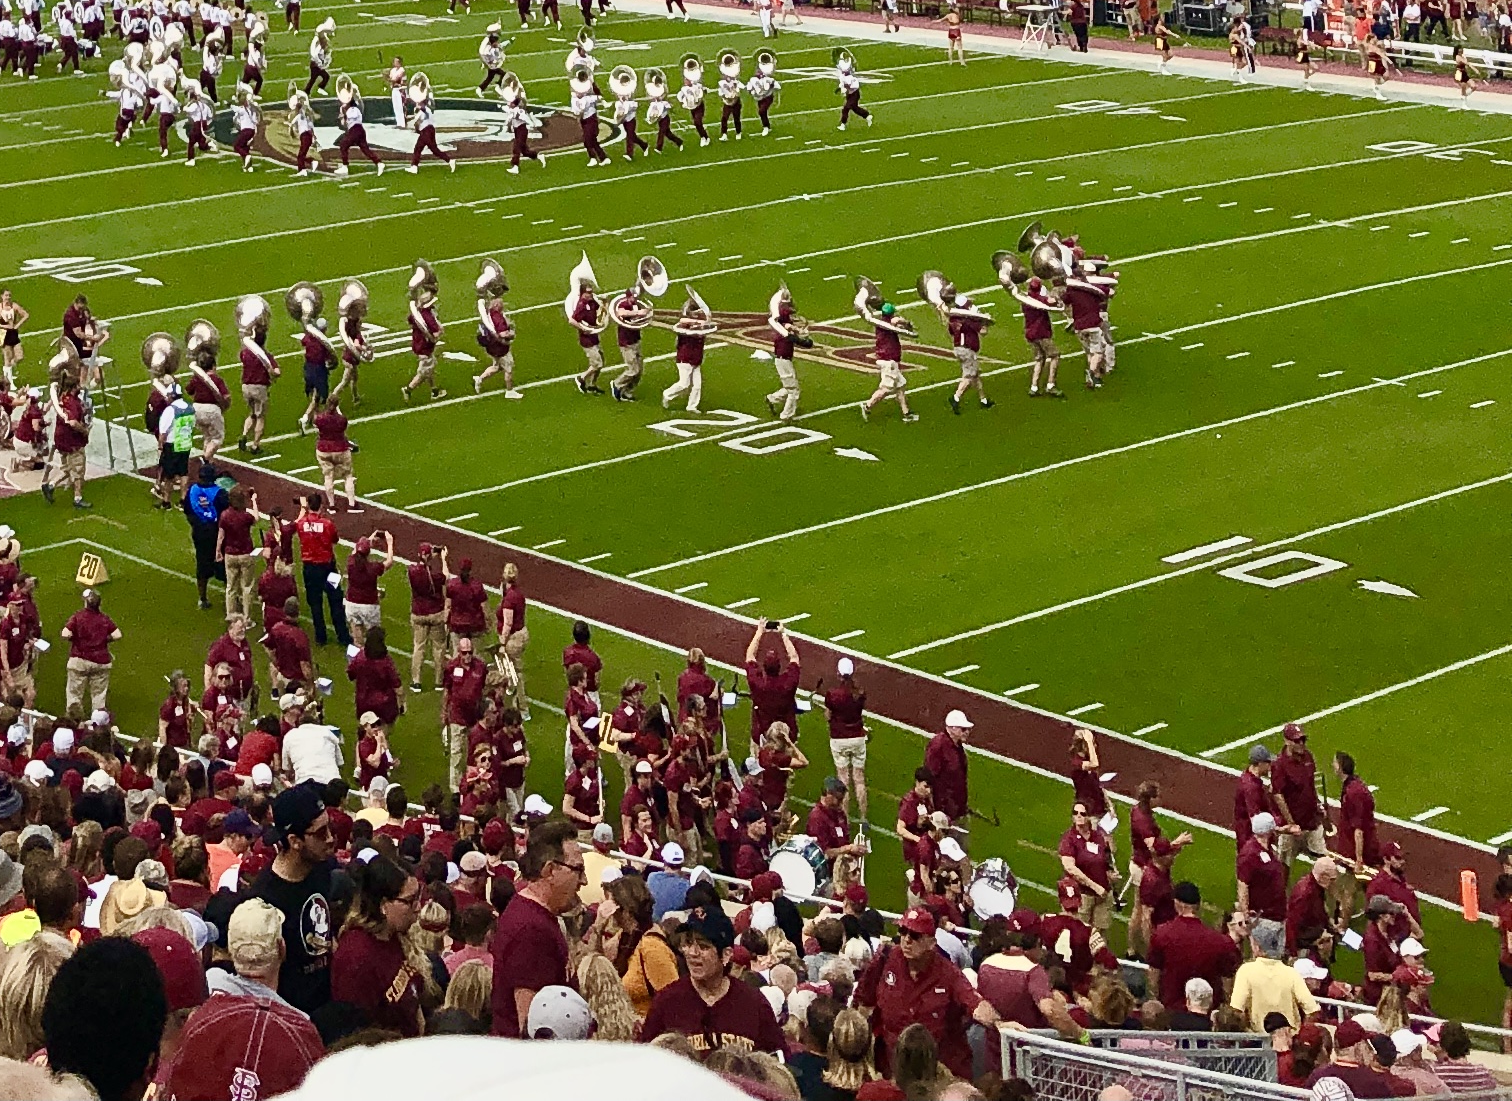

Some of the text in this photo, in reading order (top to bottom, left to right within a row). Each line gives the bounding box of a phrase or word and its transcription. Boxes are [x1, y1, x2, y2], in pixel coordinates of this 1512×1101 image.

[646, 408, 833, 455] 20
[79, 554, 99, 580] 20
[1161, 535, 1349, 589] 10
[1054, 928, 1073, 964] 4
